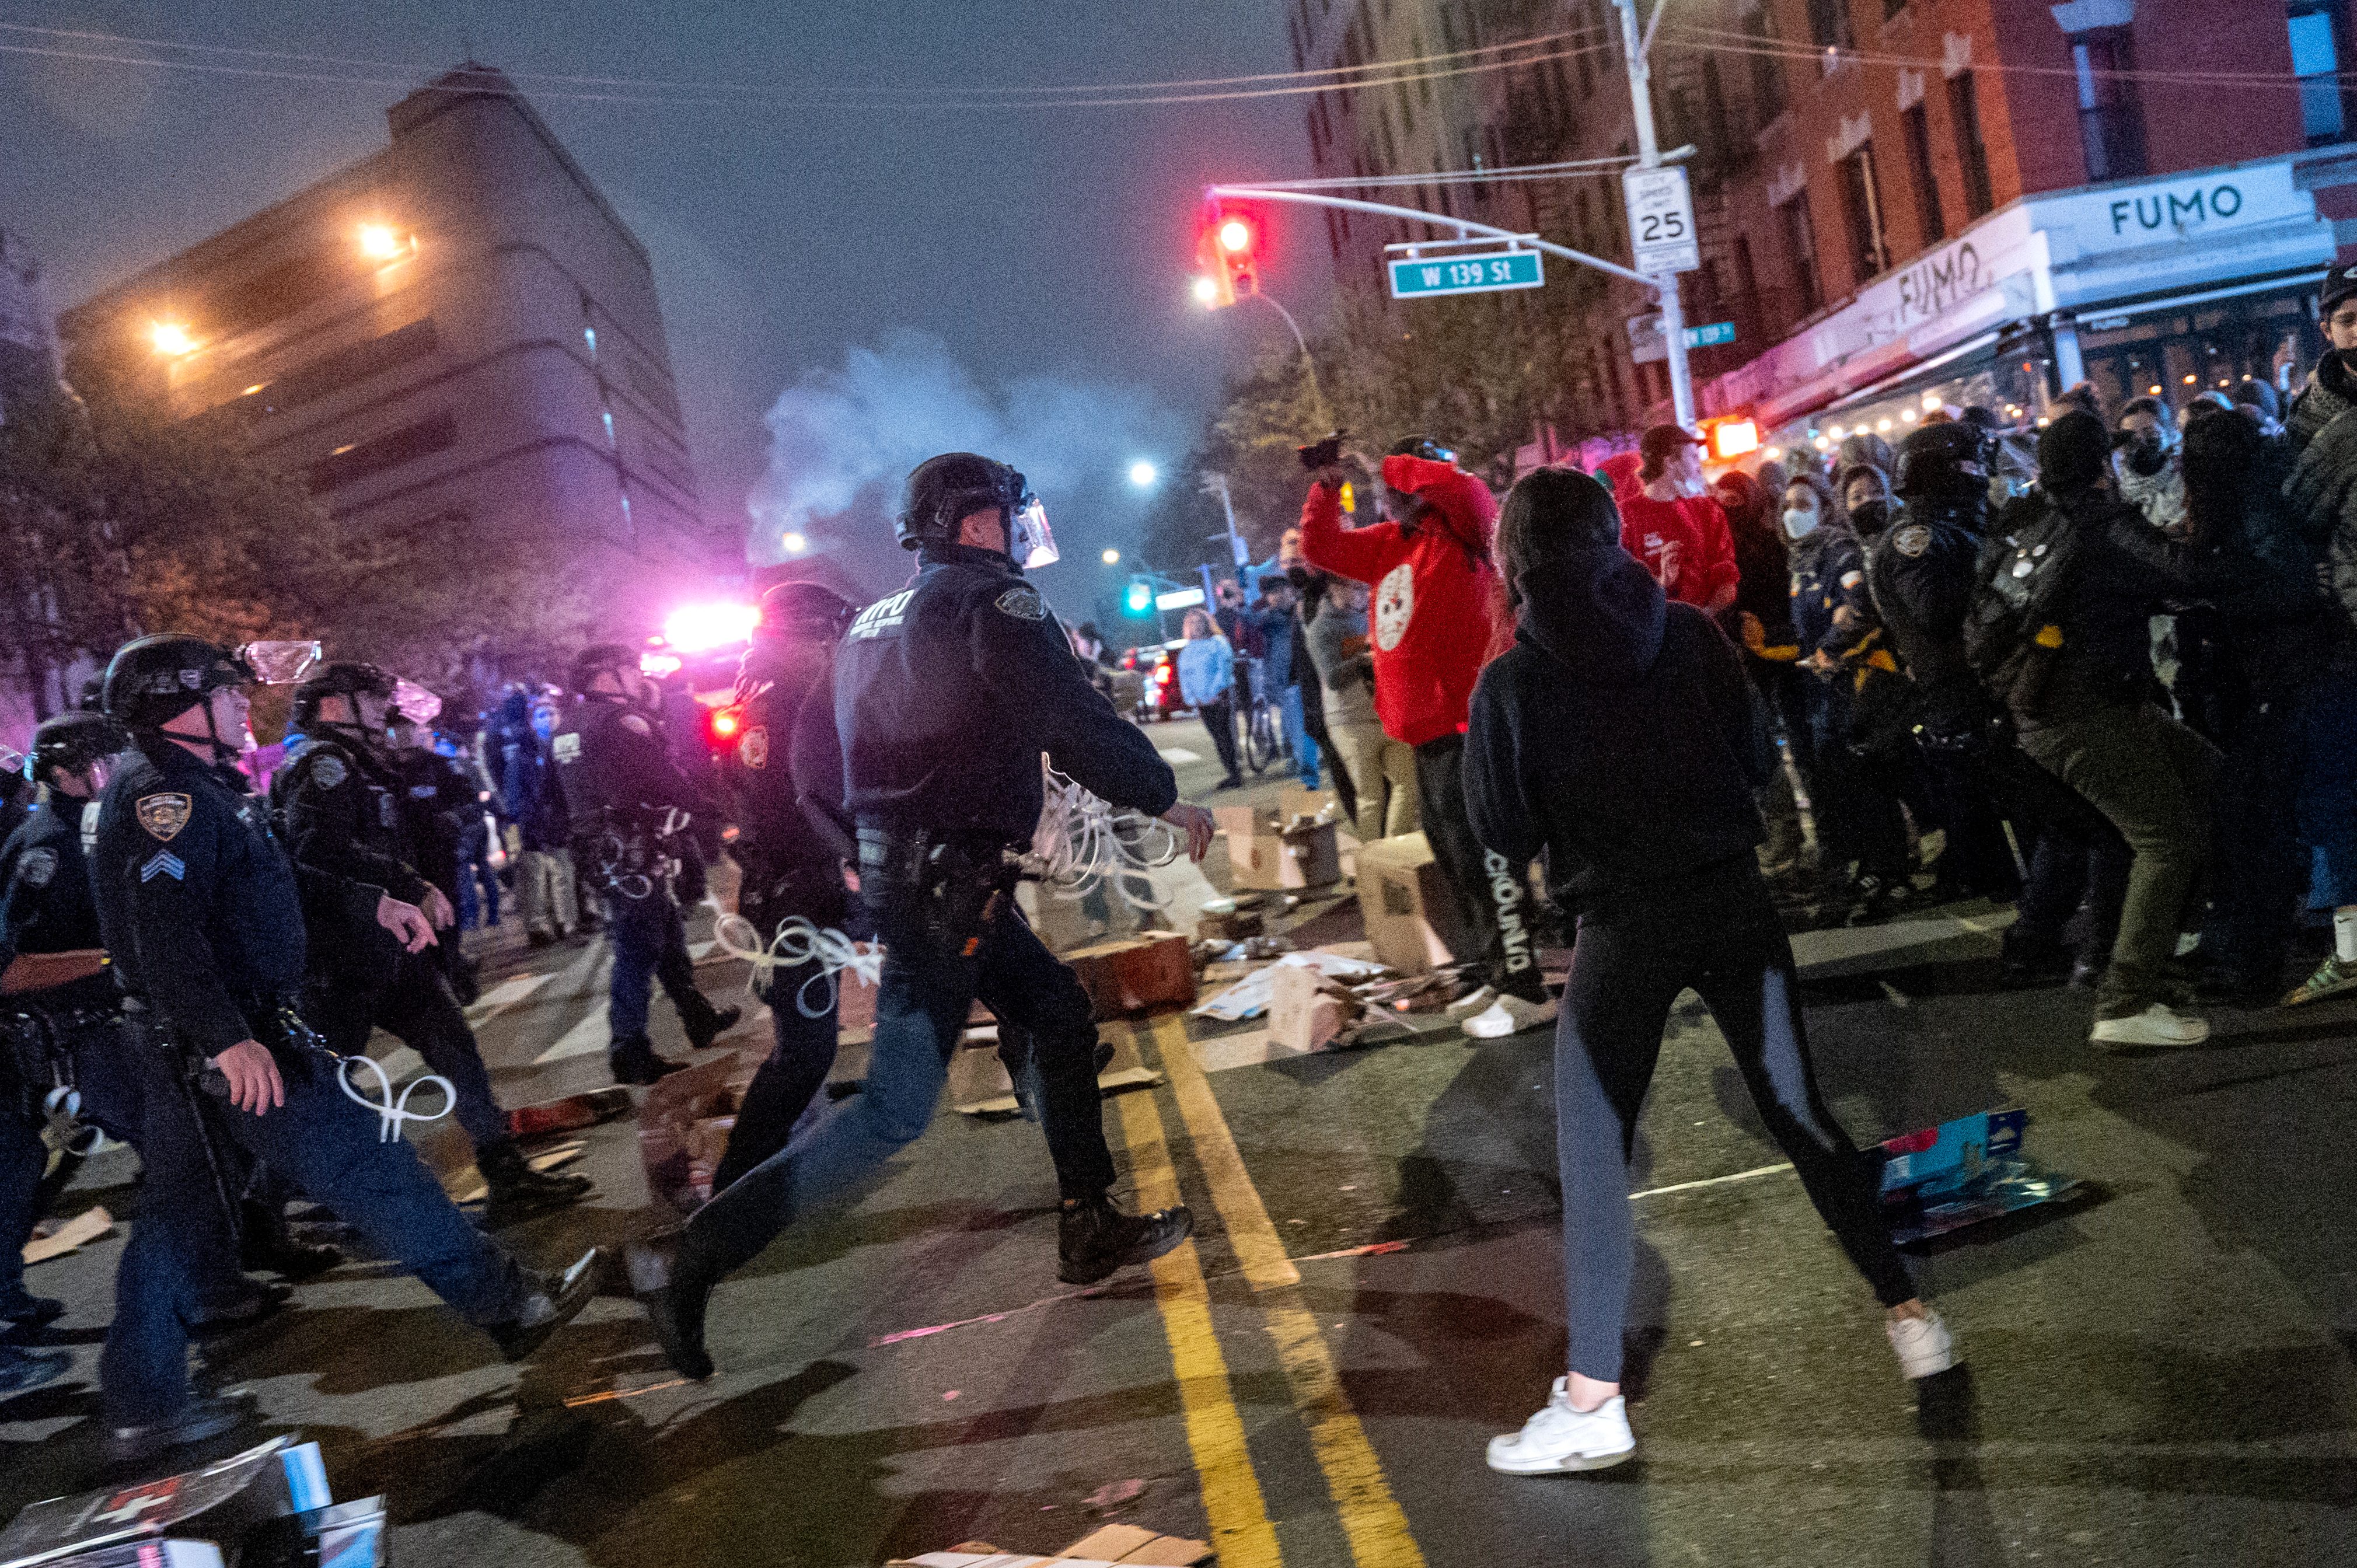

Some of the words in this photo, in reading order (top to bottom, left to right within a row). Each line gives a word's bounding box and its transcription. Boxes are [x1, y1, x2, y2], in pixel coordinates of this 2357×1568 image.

[1640, 211, 1685, 242] 25
[2110, 184, 2243, 235] FUMO
[1421, 266, 1441, 287] W
[1449, 263, 1483, 285] 139
[1899, 242, 1980, 323] FUMO
